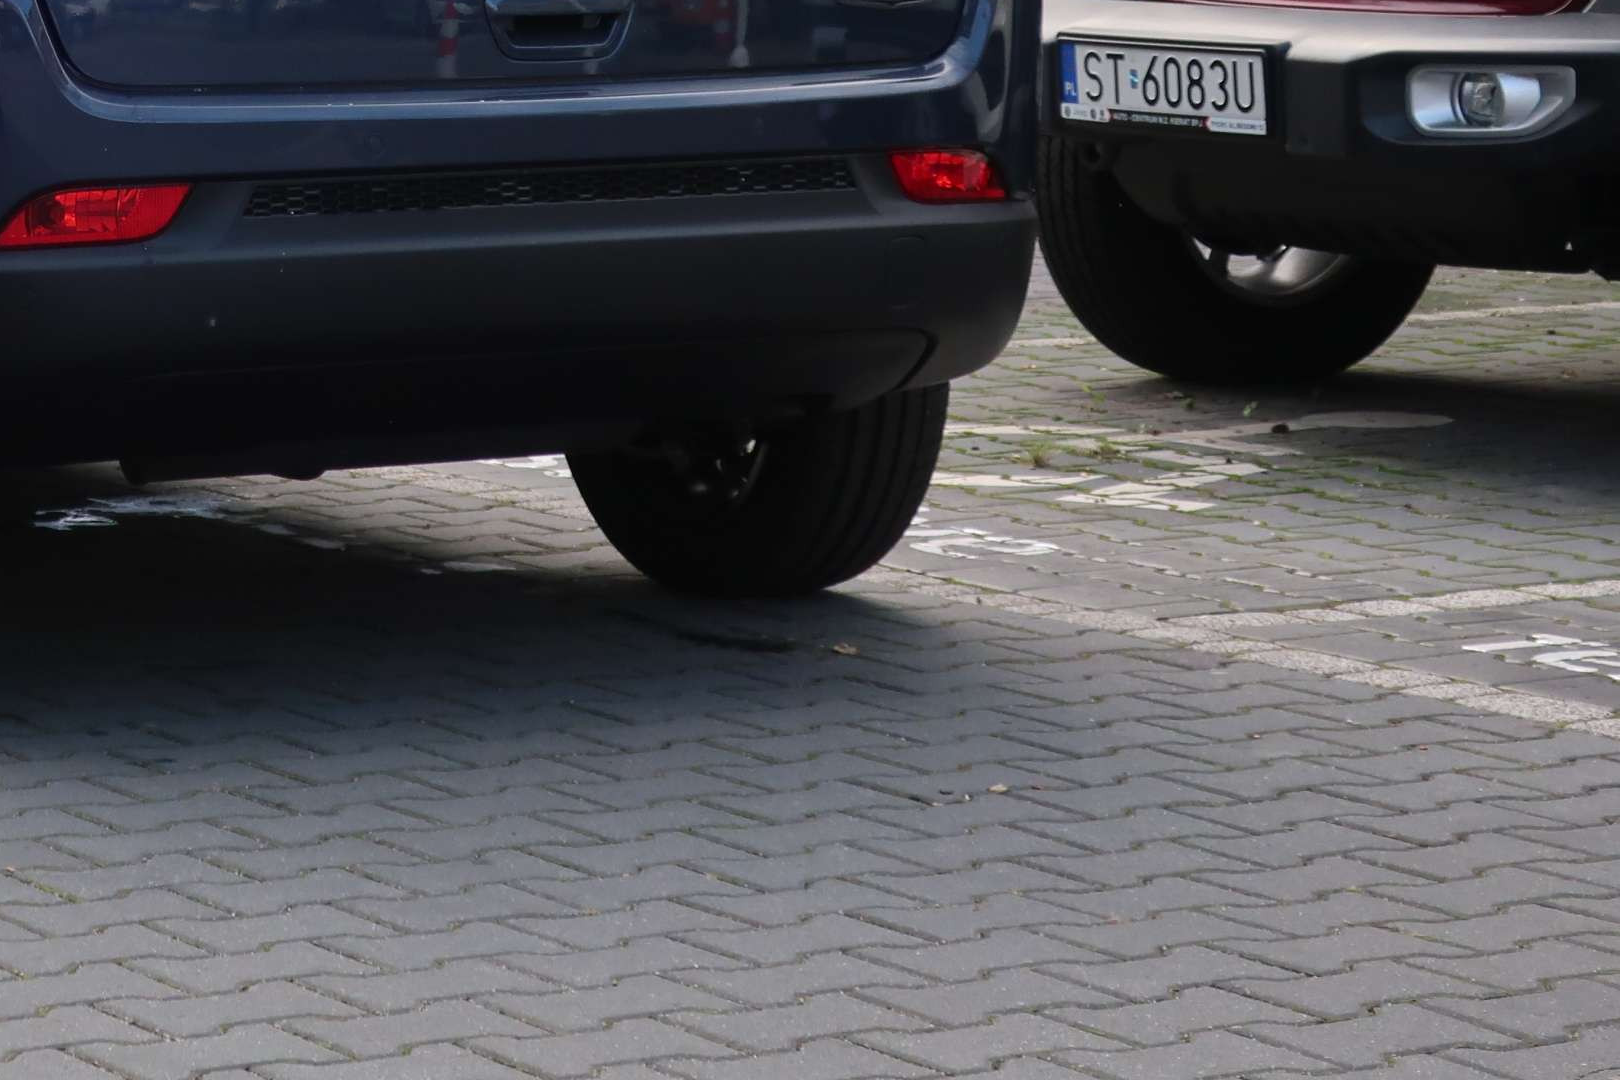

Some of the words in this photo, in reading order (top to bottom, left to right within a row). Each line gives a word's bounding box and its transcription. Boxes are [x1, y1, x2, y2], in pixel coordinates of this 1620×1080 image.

[1063, 80, 1078, 97] PL
[1083, 51, 1125, 106] ST
[1142, 55, 1256, 114] 6083U
